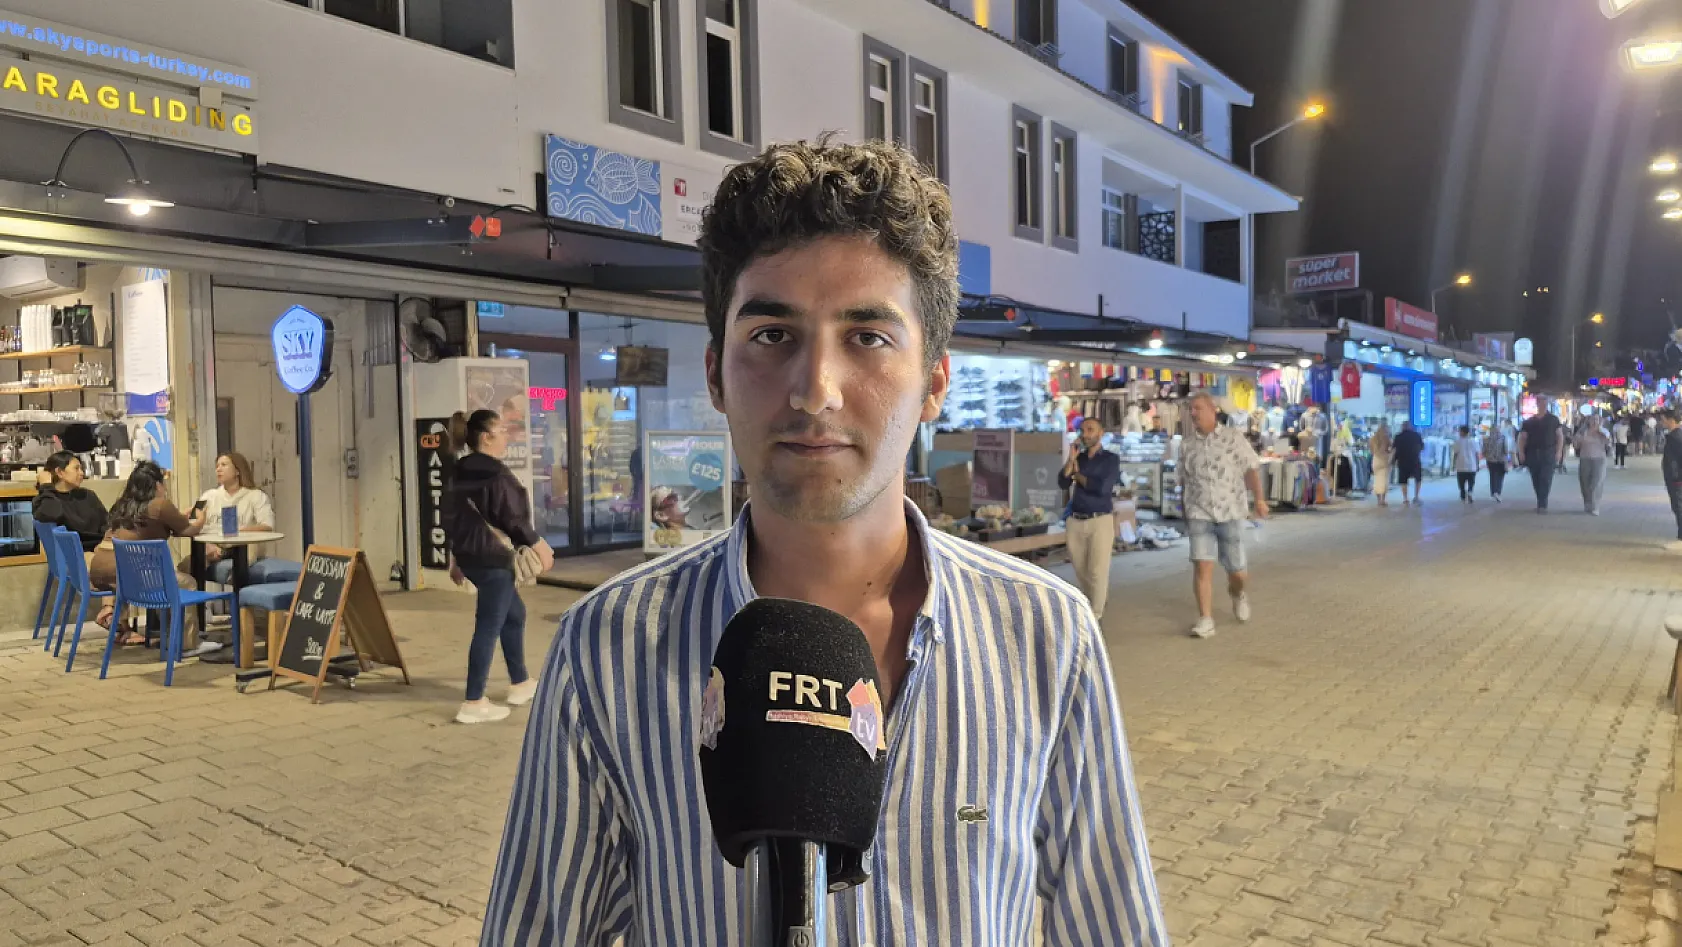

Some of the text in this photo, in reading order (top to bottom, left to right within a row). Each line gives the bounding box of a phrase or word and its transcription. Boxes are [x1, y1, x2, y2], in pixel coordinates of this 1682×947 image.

[3, 65, 253, 136] ARAGLIDING
[1292, 267, 1353, 289] market
[282, 329, 314, 355] SKY
[430, 451, 448, 564] ACTION
[314, 581, 326, 600] &
[768, 671, 843, 710] FRT
[856, 711, 876, 741] tv
